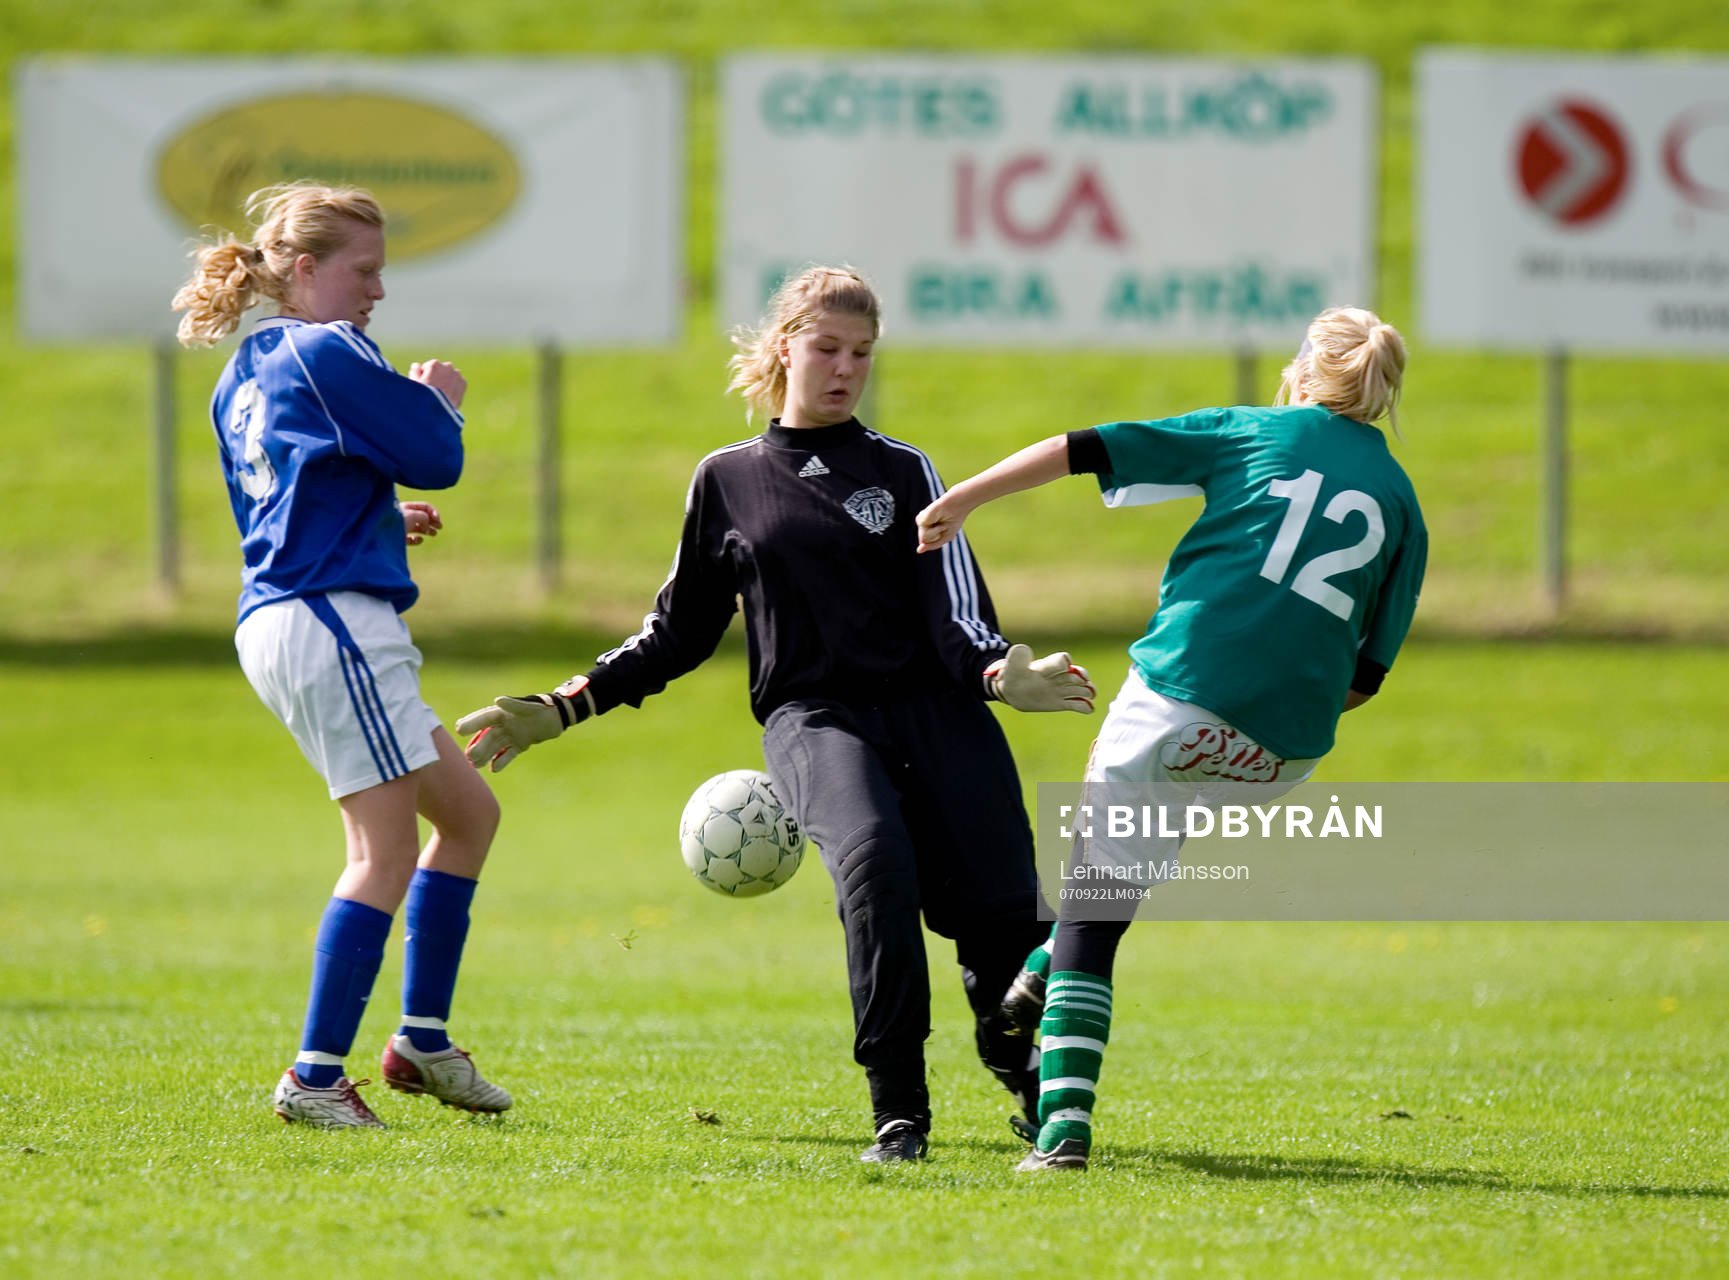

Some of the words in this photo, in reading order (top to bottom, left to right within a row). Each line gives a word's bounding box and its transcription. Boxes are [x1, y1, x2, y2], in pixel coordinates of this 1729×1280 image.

[760, 69, 1002, 138] GÖTES
[1055, 69, 1335, 144] ALLKÖP
[954, 154, 1127, 247] ICA
[906, 264, 1058, 323] BRA
[230, 377, 277, 509] 3
[1259, 468, 1386, 622] 12
